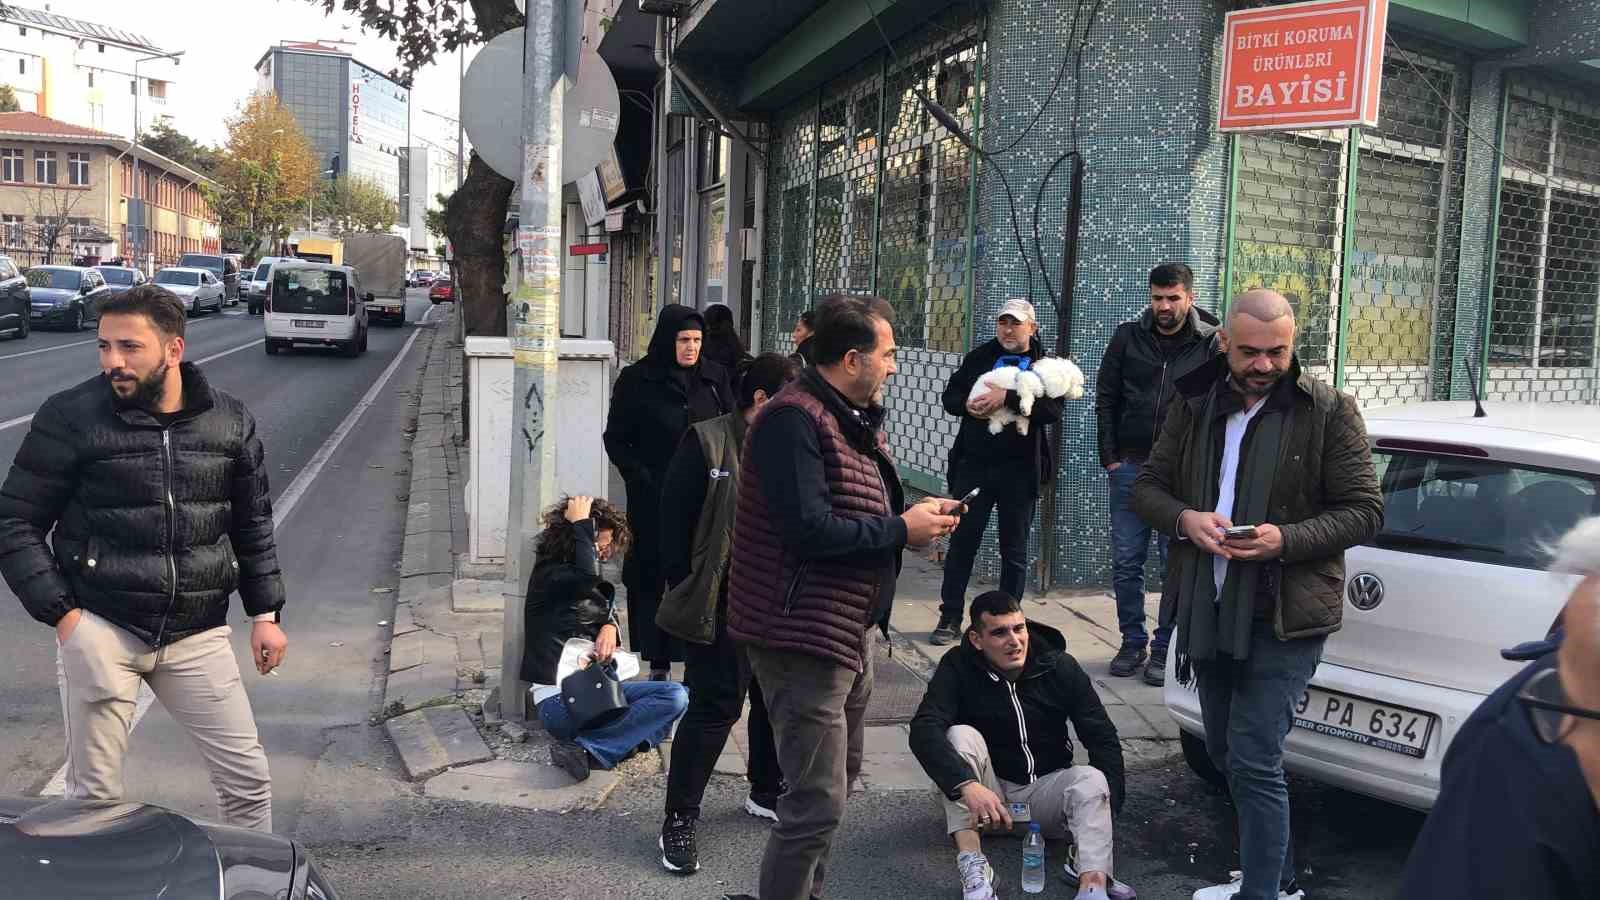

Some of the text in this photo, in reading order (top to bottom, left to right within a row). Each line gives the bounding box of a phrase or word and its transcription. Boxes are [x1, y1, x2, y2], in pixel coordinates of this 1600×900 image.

[1237, 25, 1353, 50] BİTKİ KORUMA
[1253, 49, 1333, 73] ÜRÜNLERİ
[1234, 71, 1348, 109] BAYİSİ
[352, 83, 360, 136] HOTEL
[1323, 697, 1354, 727] PA
[1369, 709, 1418, 742] 634
